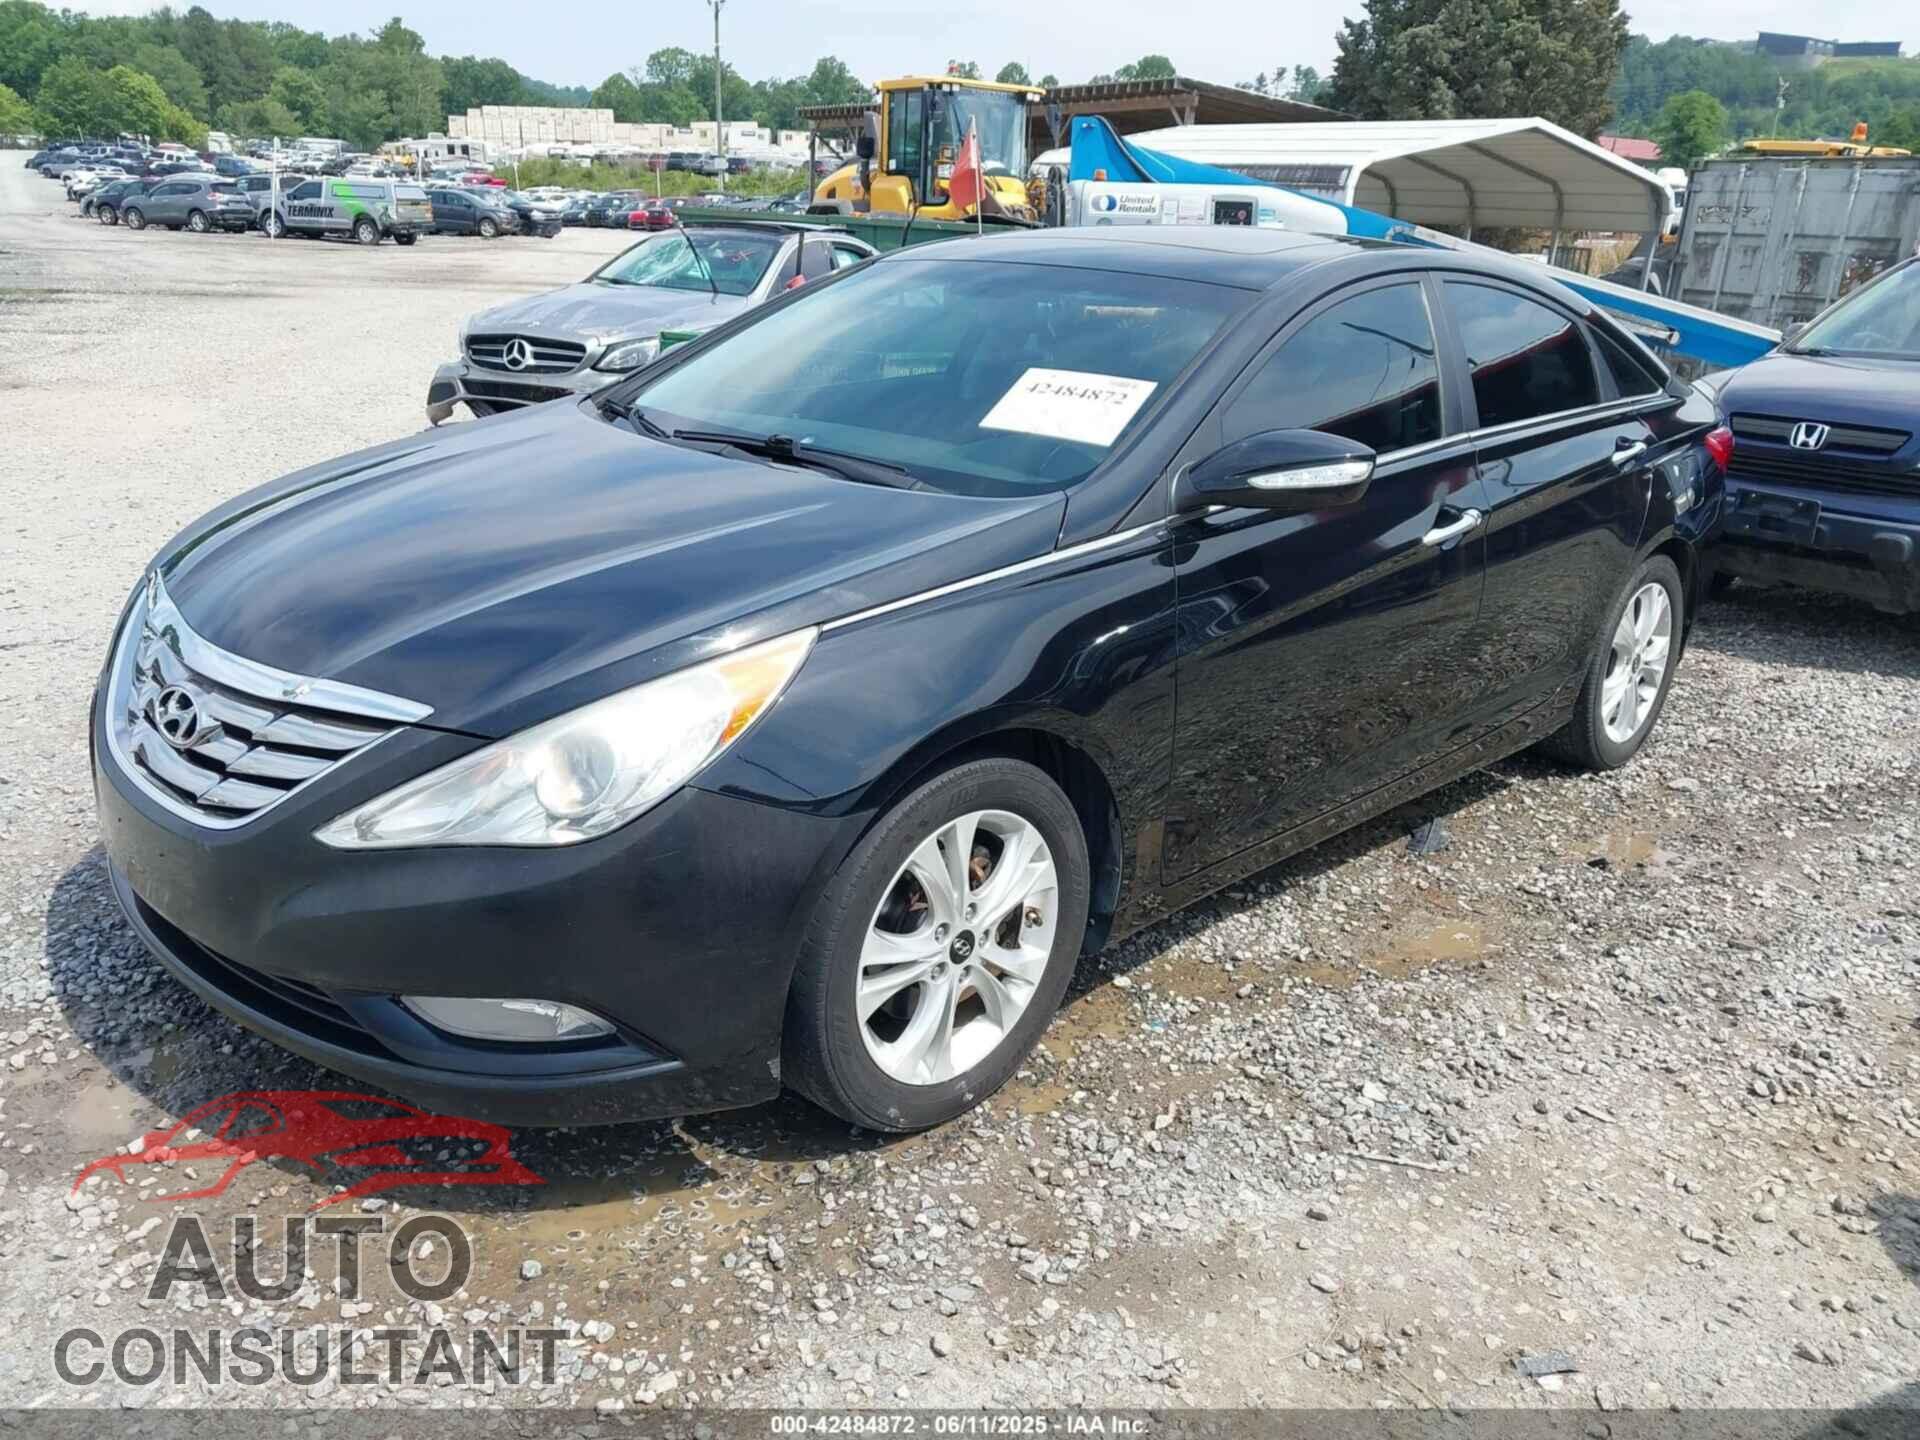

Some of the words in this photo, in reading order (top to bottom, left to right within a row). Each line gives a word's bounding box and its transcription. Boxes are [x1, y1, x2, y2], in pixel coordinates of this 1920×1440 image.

[1119, 195, 1155, 203] United
[287, 205, 334, 218] TERMINIX
[1118, 203, 1157, 213] Rentals
[1026, 383, 1128, 405] 42484872
